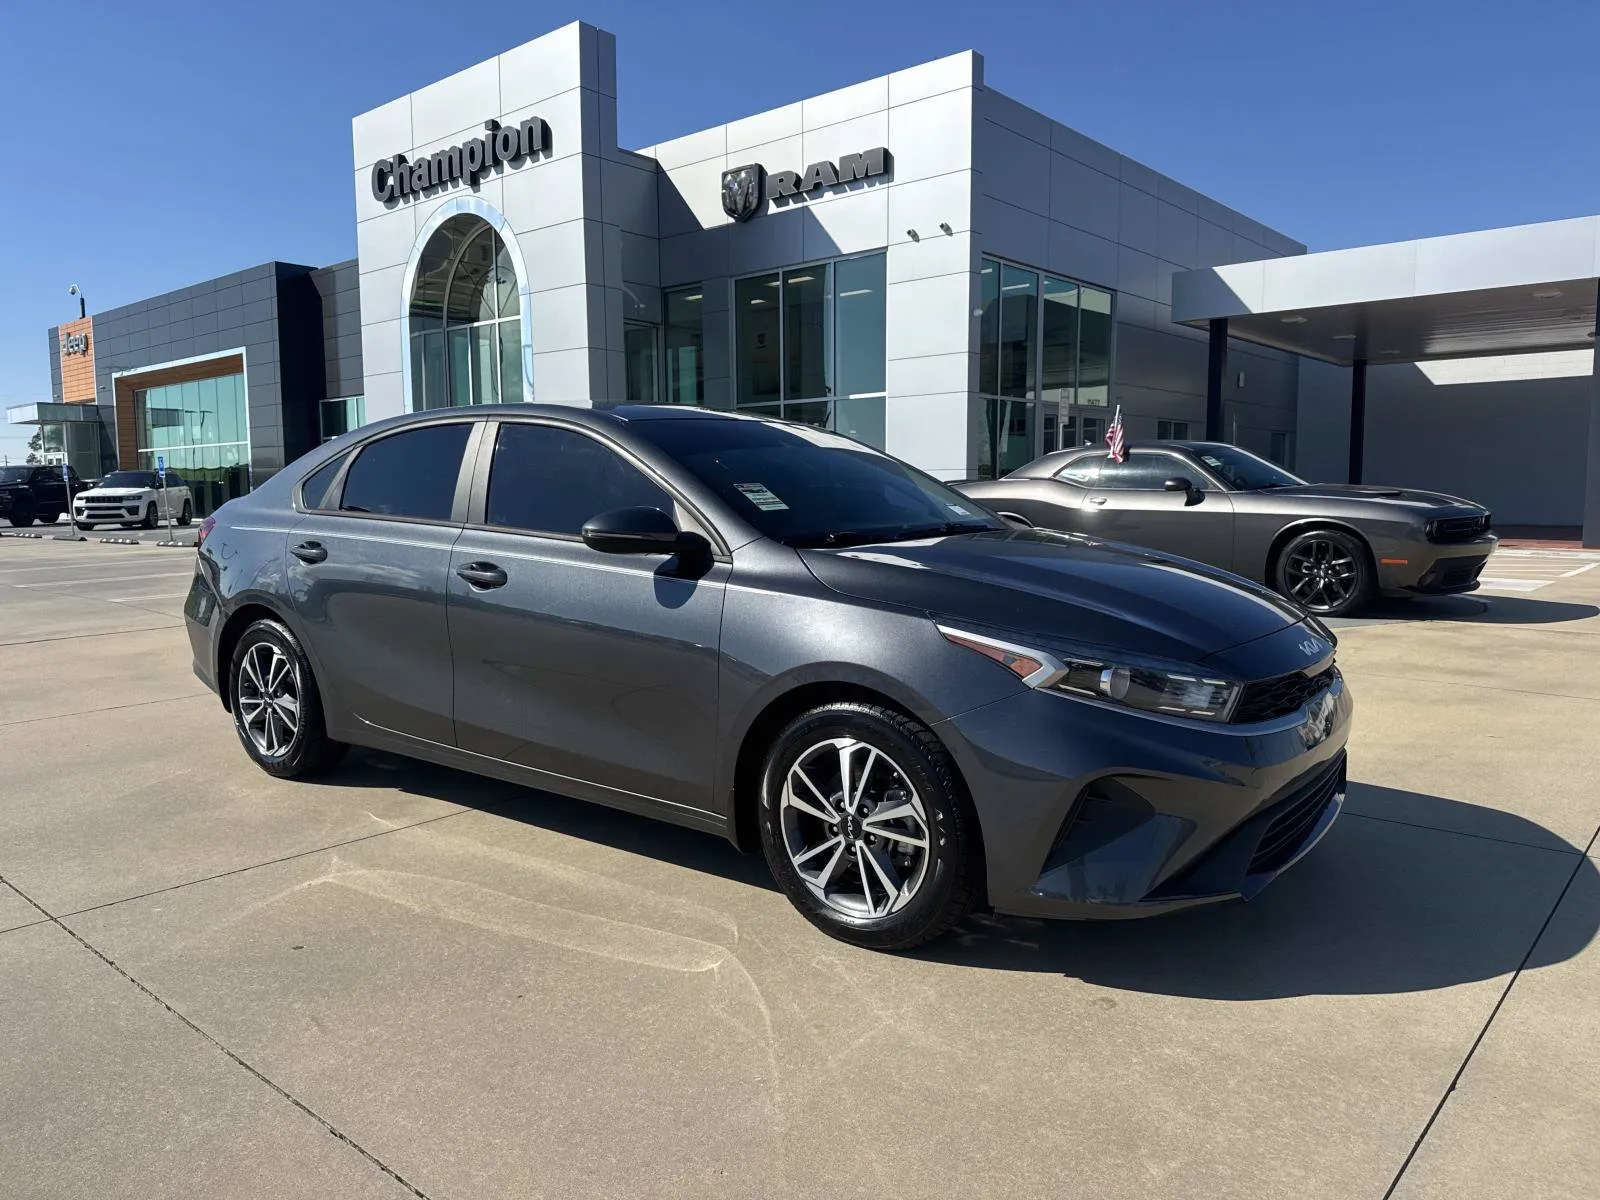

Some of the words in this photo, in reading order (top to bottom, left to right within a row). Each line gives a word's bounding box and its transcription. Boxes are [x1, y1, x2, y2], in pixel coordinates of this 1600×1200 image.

[371, 116, 550, 203] Champion
[765, 147, 889, 200] RAM
[61, 332, 87, 356] Jeep
[1298, 638, 1323, 656] KIA
